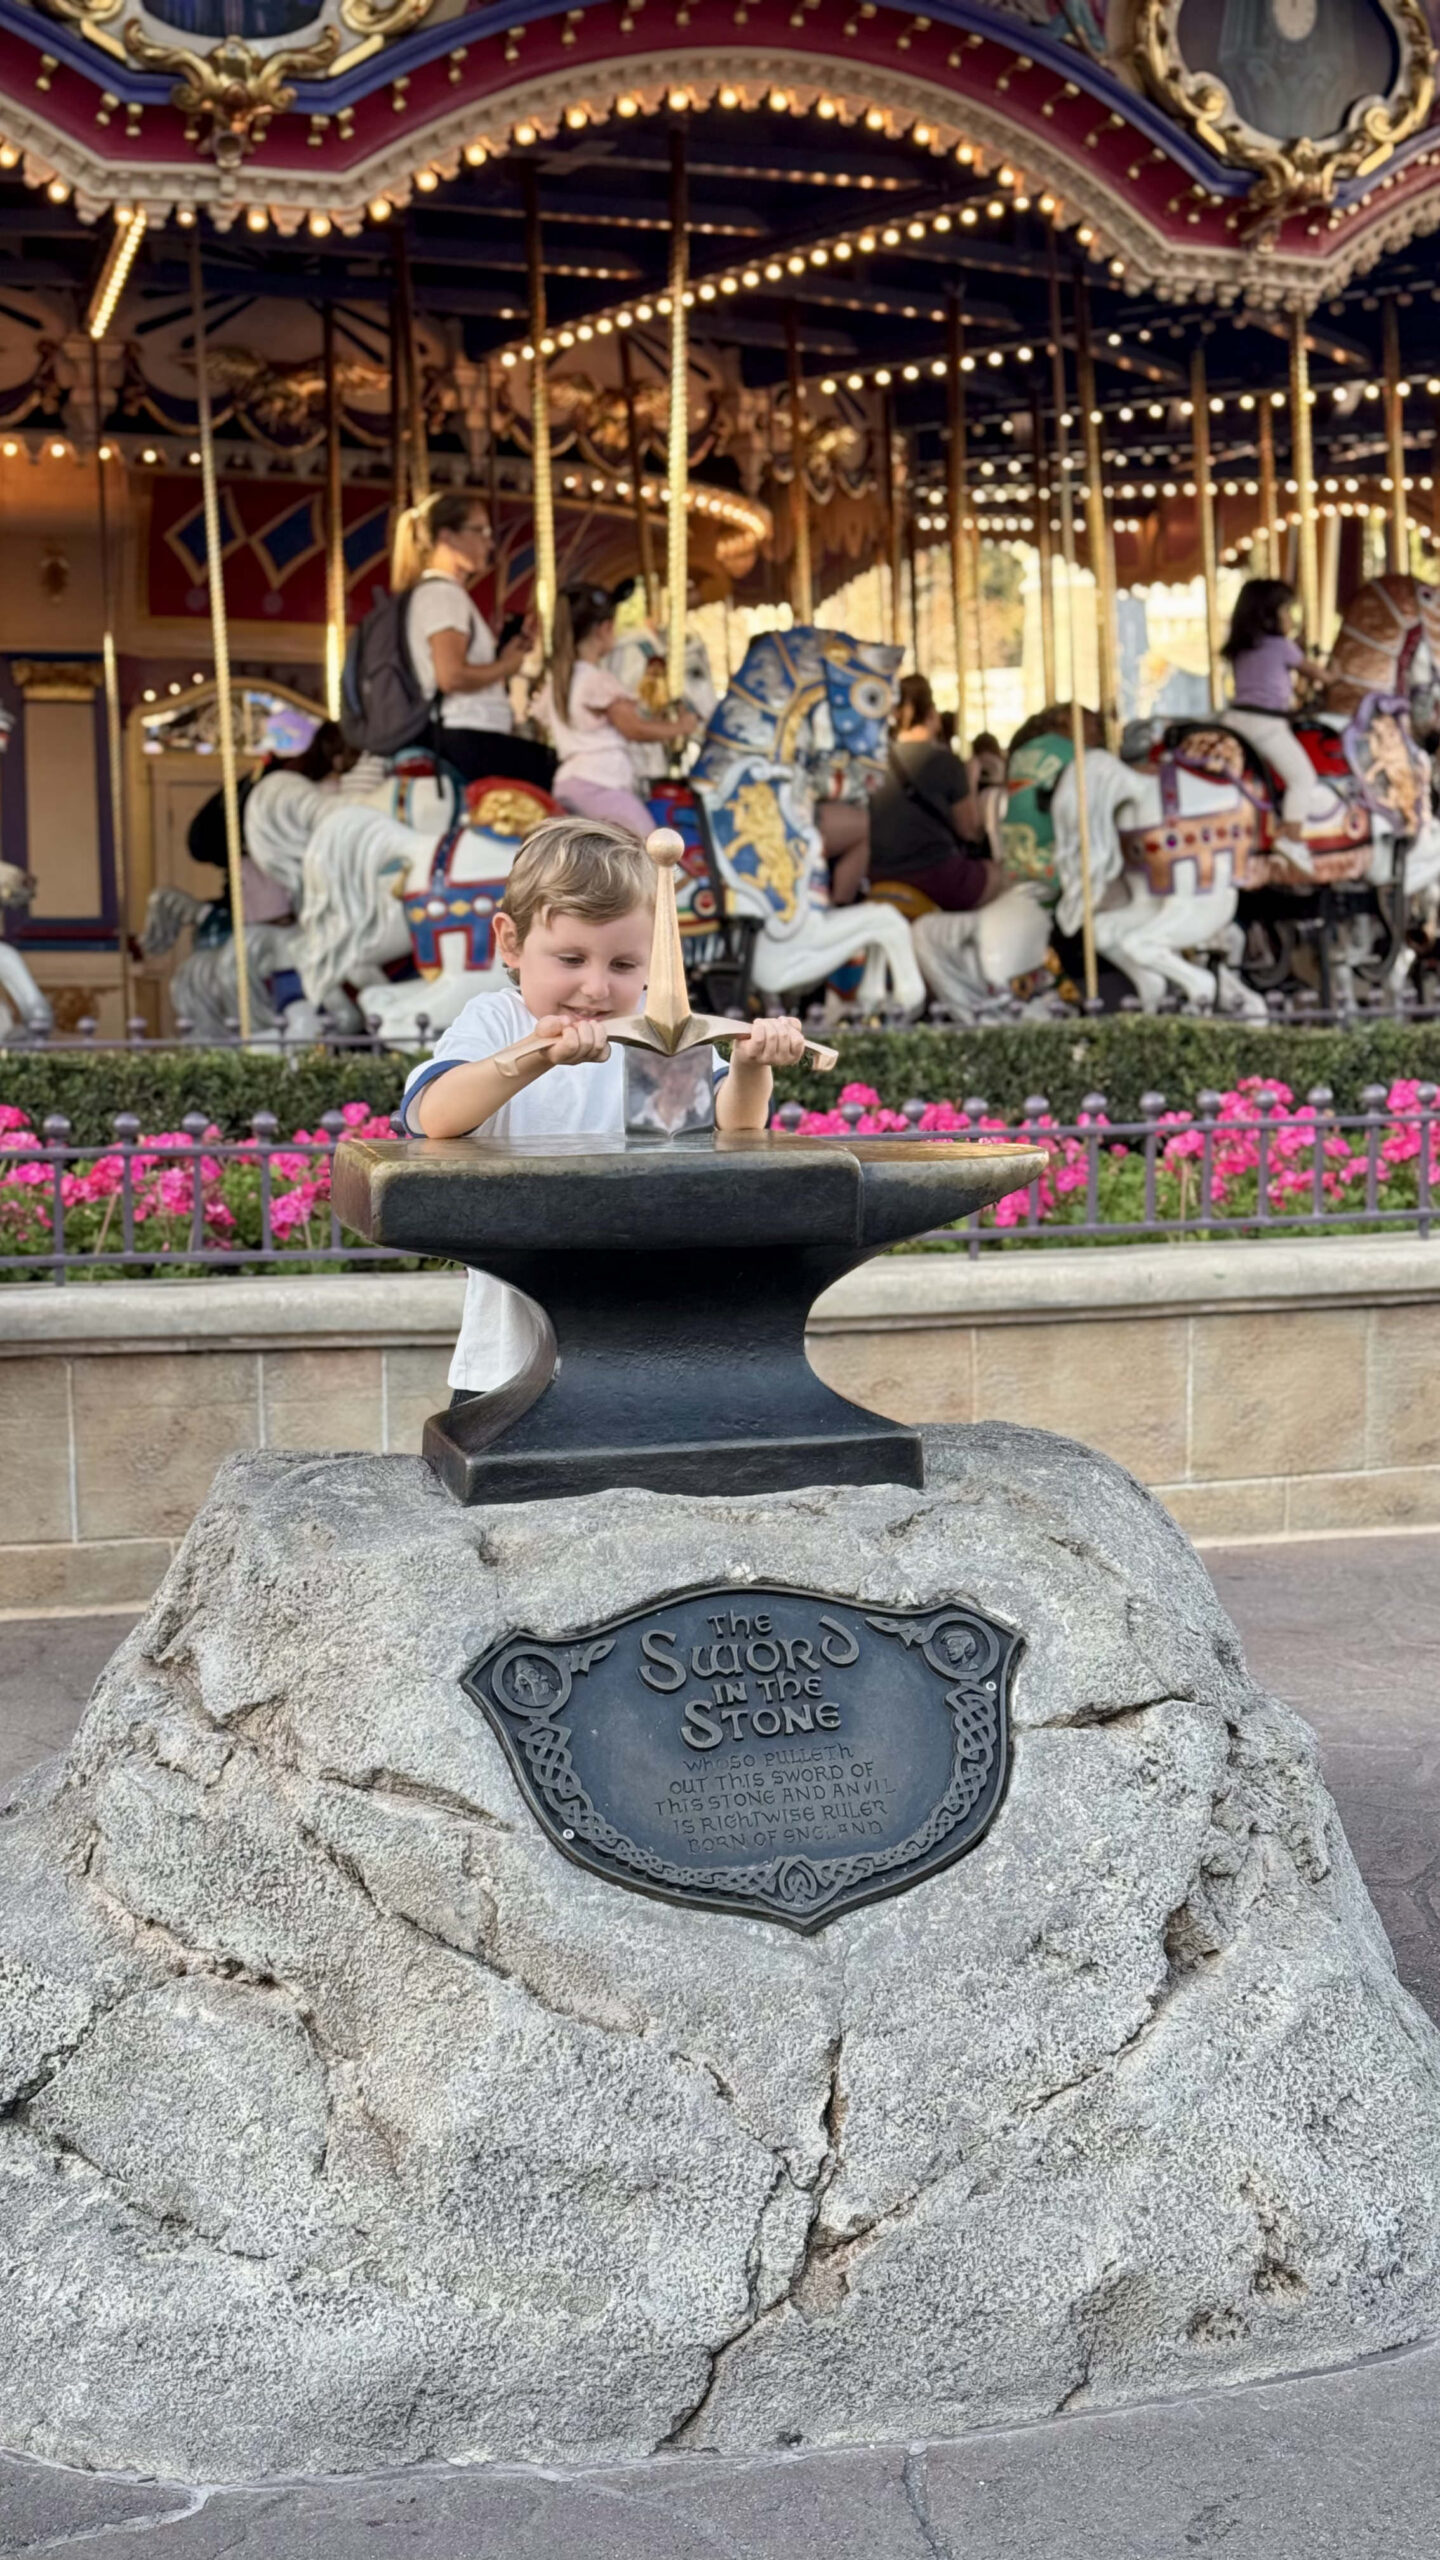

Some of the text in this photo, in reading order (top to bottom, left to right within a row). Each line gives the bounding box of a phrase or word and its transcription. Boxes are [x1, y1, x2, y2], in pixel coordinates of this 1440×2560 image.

[707, 1610, 773, 1639] THE
[638, 1615, 860, 1693] SWORD
[713, 1671, 823, 1706] IN THE
[680, 1699, 842, 1749] STONE
[669, 1761, 874, 1795] OUT THIS SWORD OF
[655, 1778, 897, 1816] THIS STONE AND ANVIL
[673, 1818, 696, 1834] IS
[822, 1799, 889, 1820] RULER
[753, 1829, 777, 1846] OF
